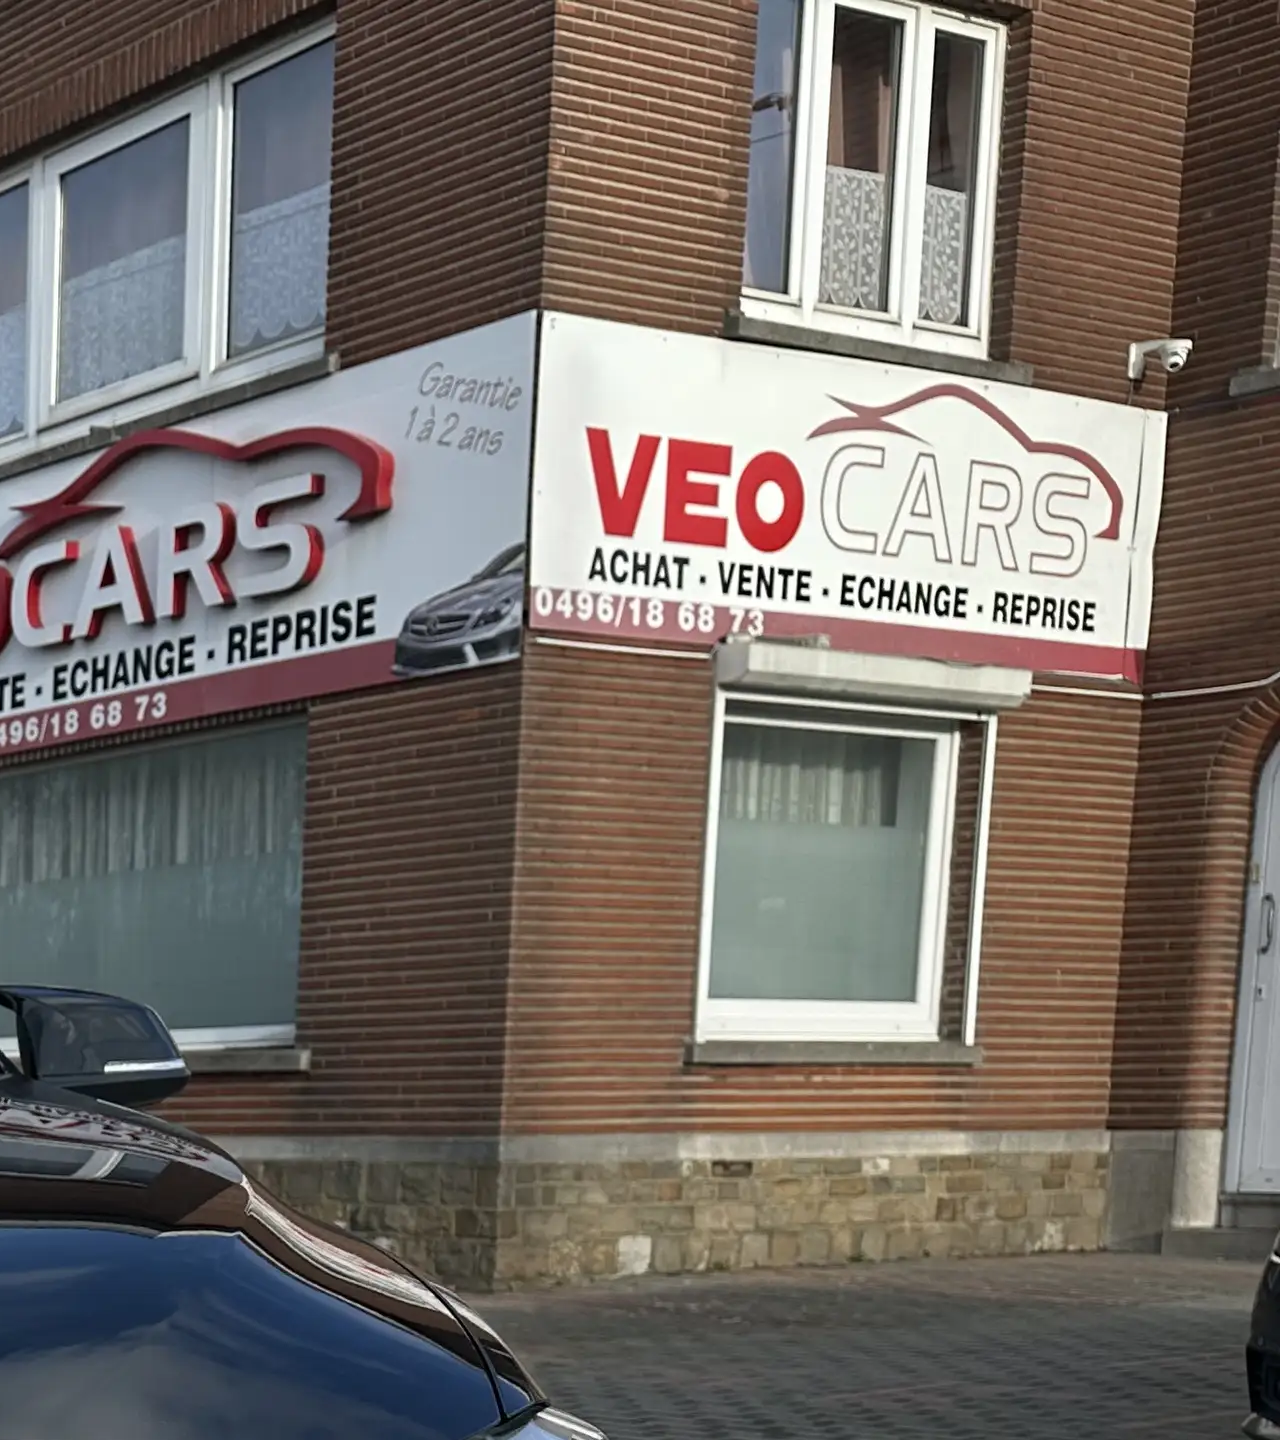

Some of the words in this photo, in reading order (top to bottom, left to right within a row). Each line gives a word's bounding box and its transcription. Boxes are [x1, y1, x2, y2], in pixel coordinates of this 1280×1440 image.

[418, 361, 523, 412] Garantie
[404, 405, 419, 439] 1
[436, 411, 460, 447] 2
[457, 426, 504, 455] ans
[585, 426, 804, 553] VEO
[820, 443, 1091, 578] CARS
[10, 472, 326, 648] CARS
[588, 546, 690, 591] ACHAT
[718, 560, 813, 603] VENTE
[840, 574, 968, 620] ECHANGE
[992, 592, 1096, 634] REPRISE
[535, 587, 665, 629] 0496/18
[678, 601, 715, 633] 68
[729, 606, 764, 637] 73
[52, 636, 197, 700] ECHANGE
[227, 596, 378, 667] REPRISE
[90, 700, 122, 730] 68
[135, 691, 168, 721] 73
